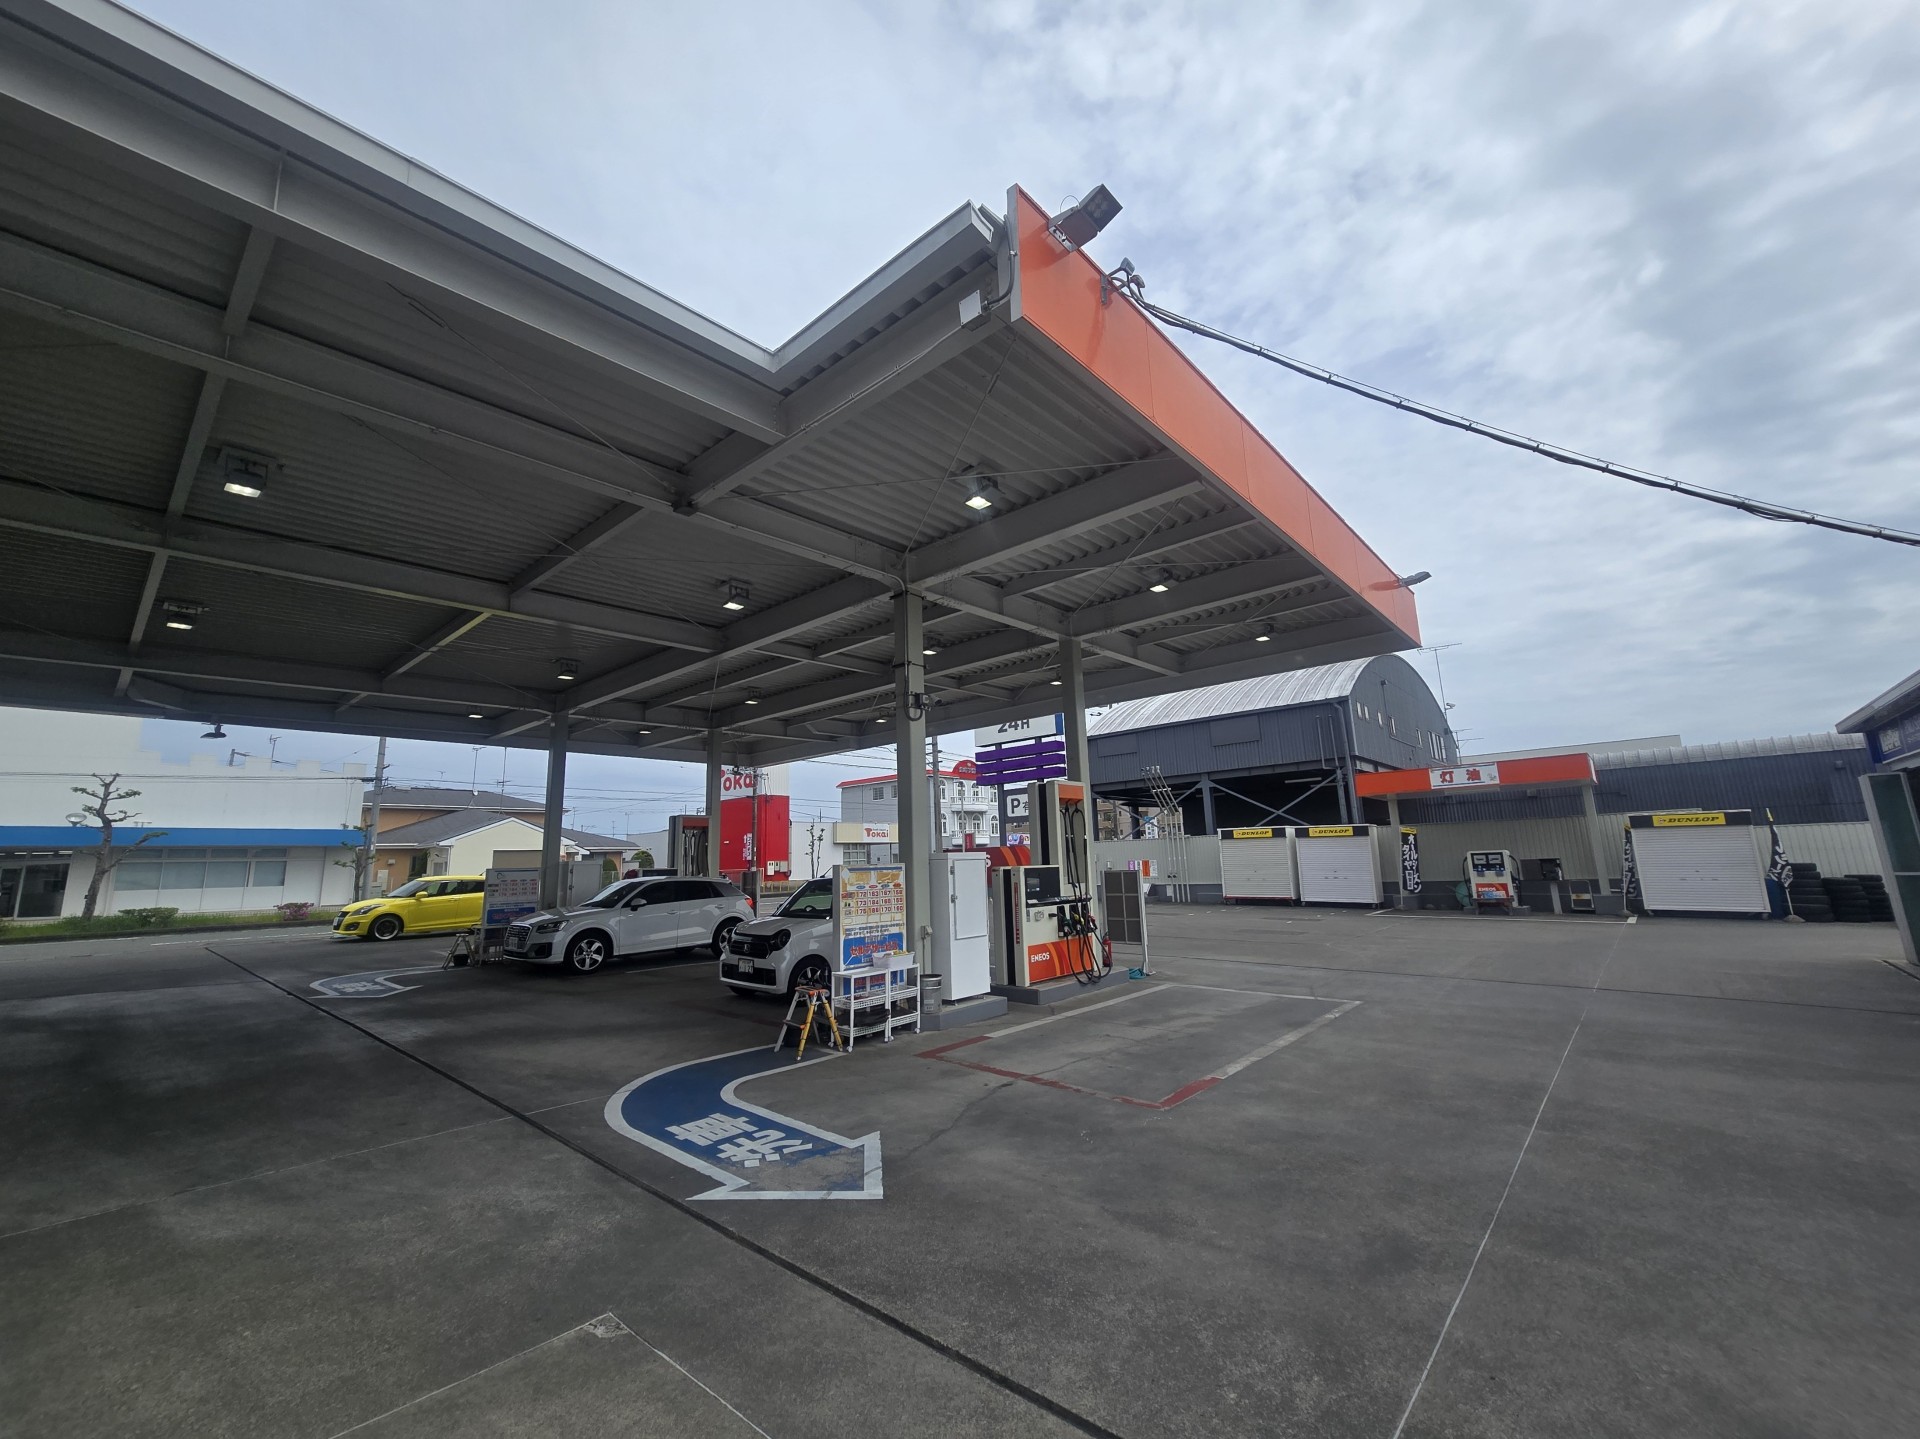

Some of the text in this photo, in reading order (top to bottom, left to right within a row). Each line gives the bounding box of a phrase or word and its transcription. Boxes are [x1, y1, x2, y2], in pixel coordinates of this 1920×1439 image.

[1439, 768, 1481, 784] 灯油
[1667, 815, 1720, 824] DUNLOP
[1030, 952, 1050, 962] ENEOS
[664, 1112, 813, 1168] 洗車
